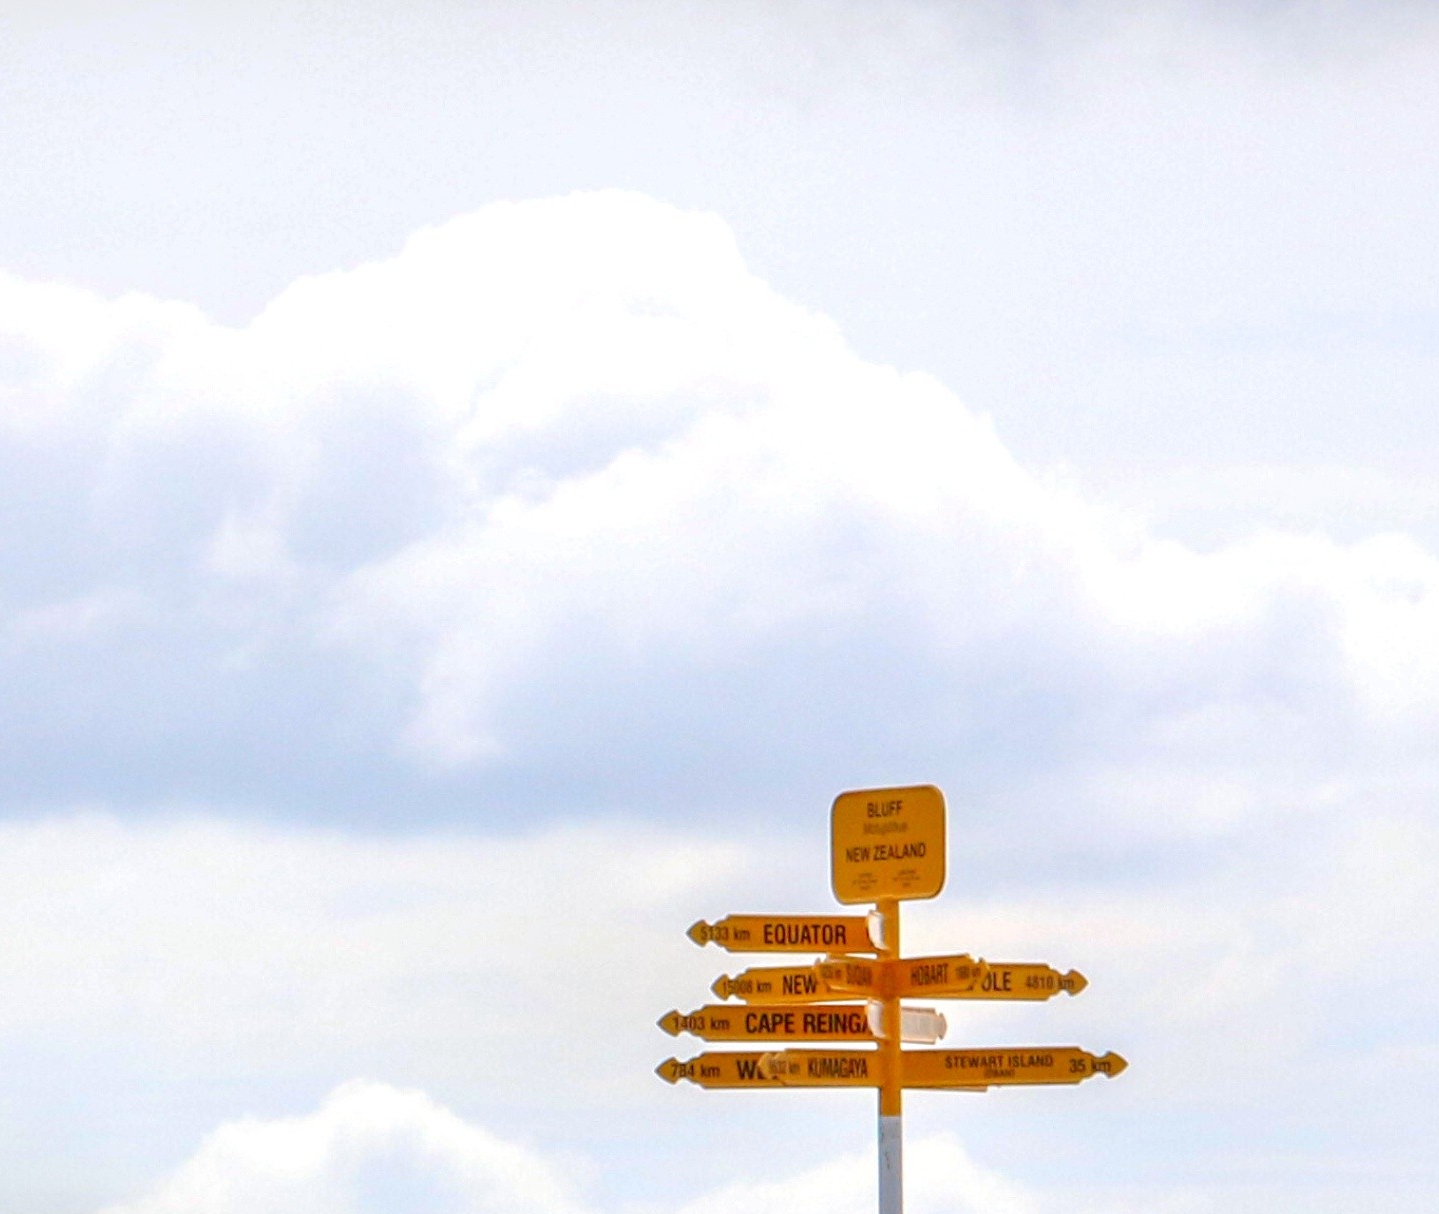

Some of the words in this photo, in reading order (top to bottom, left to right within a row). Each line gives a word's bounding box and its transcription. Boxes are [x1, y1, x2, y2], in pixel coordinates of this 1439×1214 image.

[866, 801, 903, 818] BLUFF
[845, 846, 870, 863] NEW
[874, 842, 926, 860] ZEALAND
[733, 927, 751, 941] km
[764, 924, 846, 944] EQUATOR
[911, 963, 949, 985] HOBART
[1058, 977, 1075, 990] km
[756, 981, 772, 993] km
[782, 974, 818, 995] NEW
[710, 1016, 730, 1031] km
[745, 1013, 795, 1034] CAPE
[700, 1065, 721, 1078] km
[945, 1056, 1003, 1069] STEWART
[1007, 1054, 1054, 1068] ISLAND
[1069, 1059, 1086, 1073] 35
[1091, 1060, 1111, 1073] km
